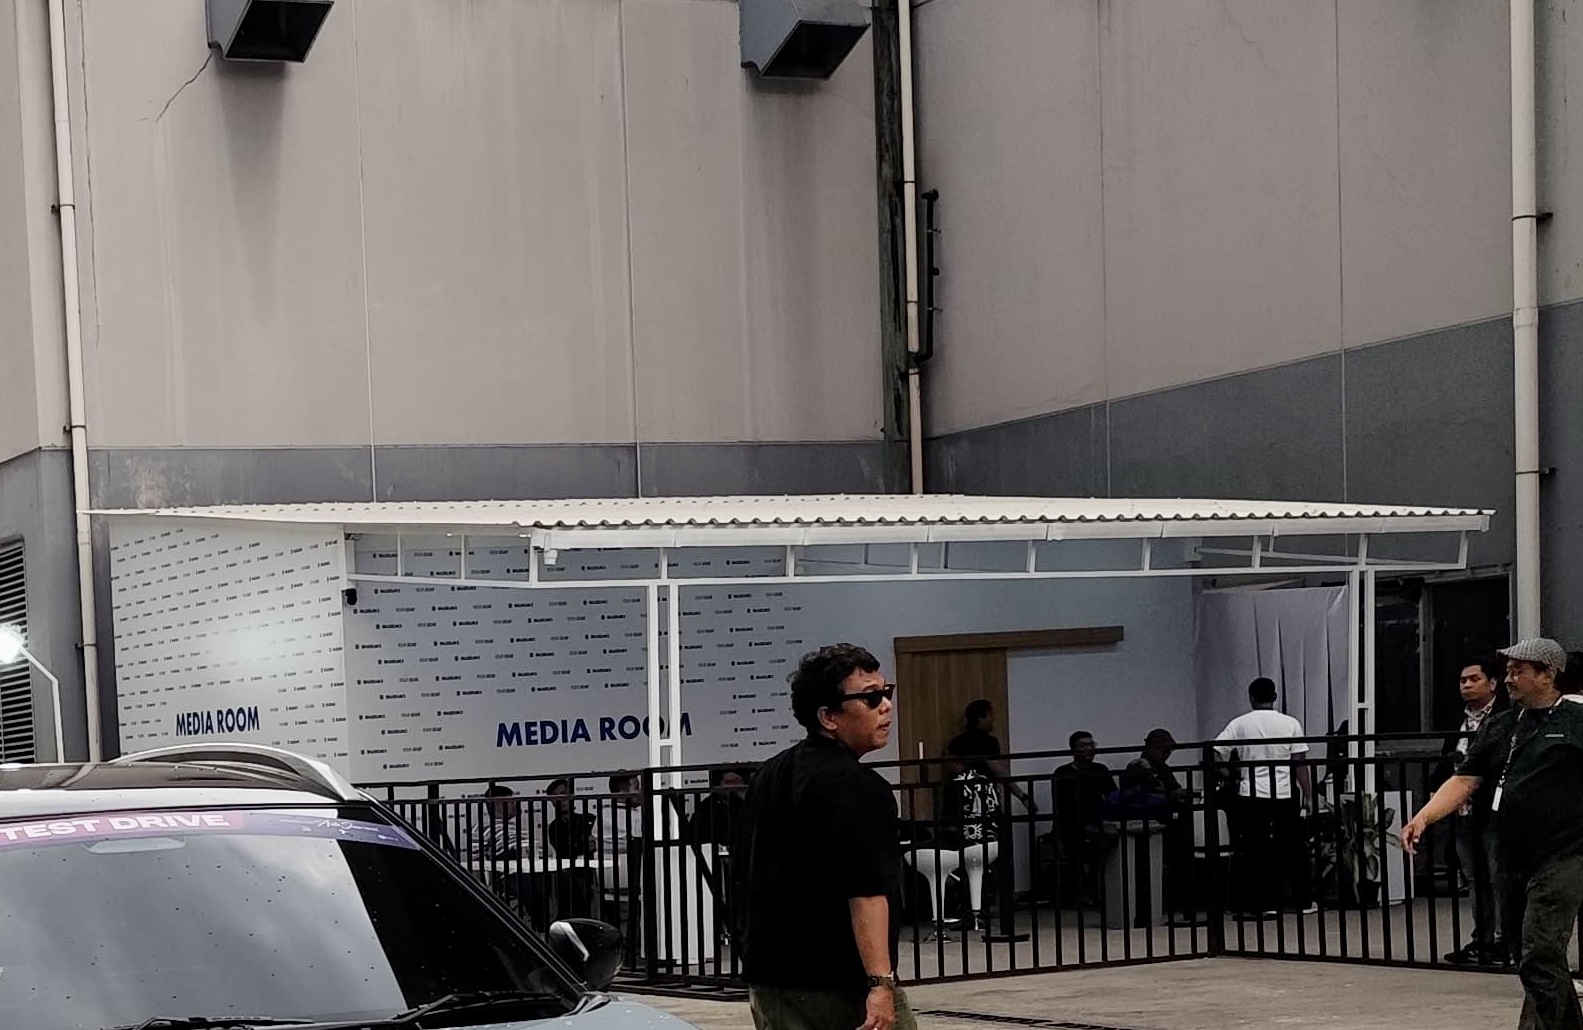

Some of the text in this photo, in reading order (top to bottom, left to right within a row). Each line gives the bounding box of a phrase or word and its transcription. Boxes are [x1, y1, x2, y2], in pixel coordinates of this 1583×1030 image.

[176, 710, 215, 737] MEDIA
[217, 705, 260, 734] ROOM
[496, 718, 592, 748] MEDIA
[108, 814, 231, 831] DRIVE
